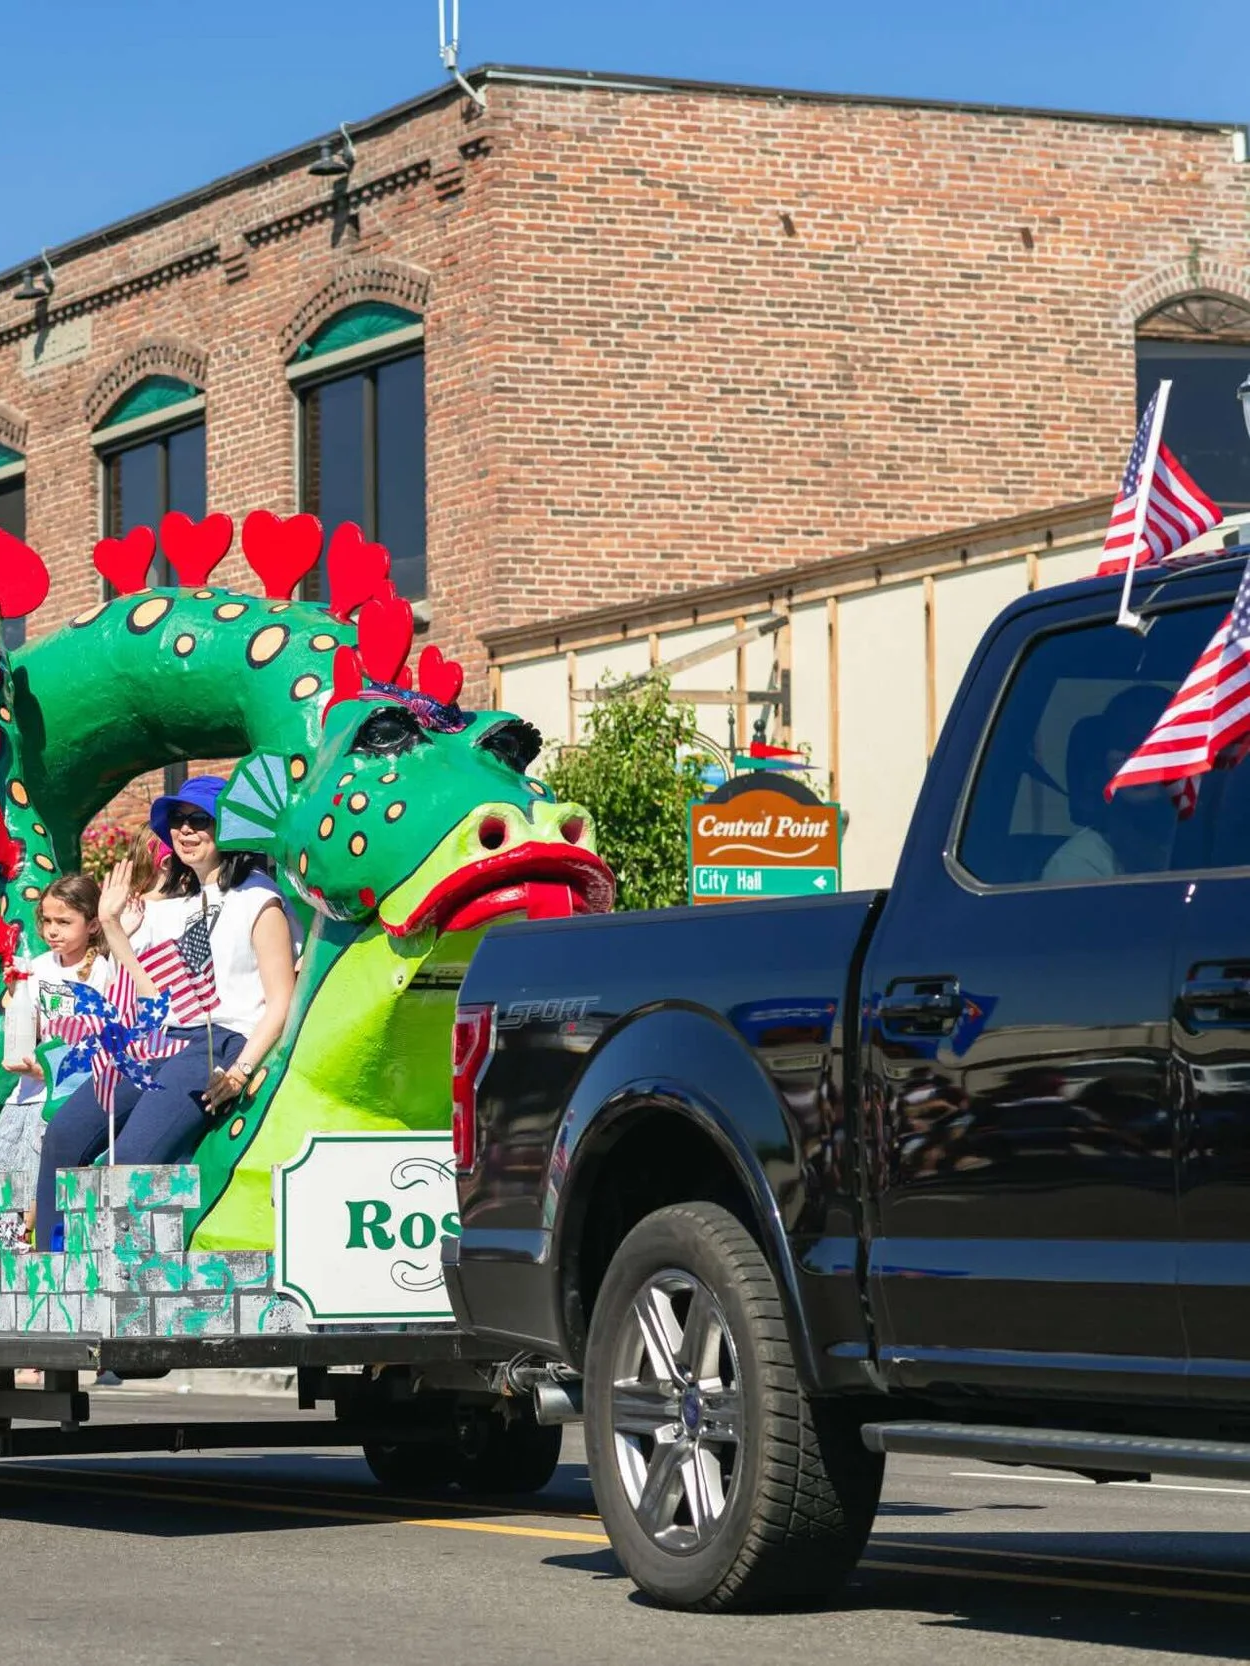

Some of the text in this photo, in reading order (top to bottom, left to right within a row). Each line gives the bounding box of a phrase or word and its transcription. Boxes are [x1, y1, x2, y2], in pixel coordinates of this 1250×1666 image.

[697, 814, 830, 839] Central Point
[698, 869, 762, 896] City Hall
[497, 996, 601, 1029] SPORT
